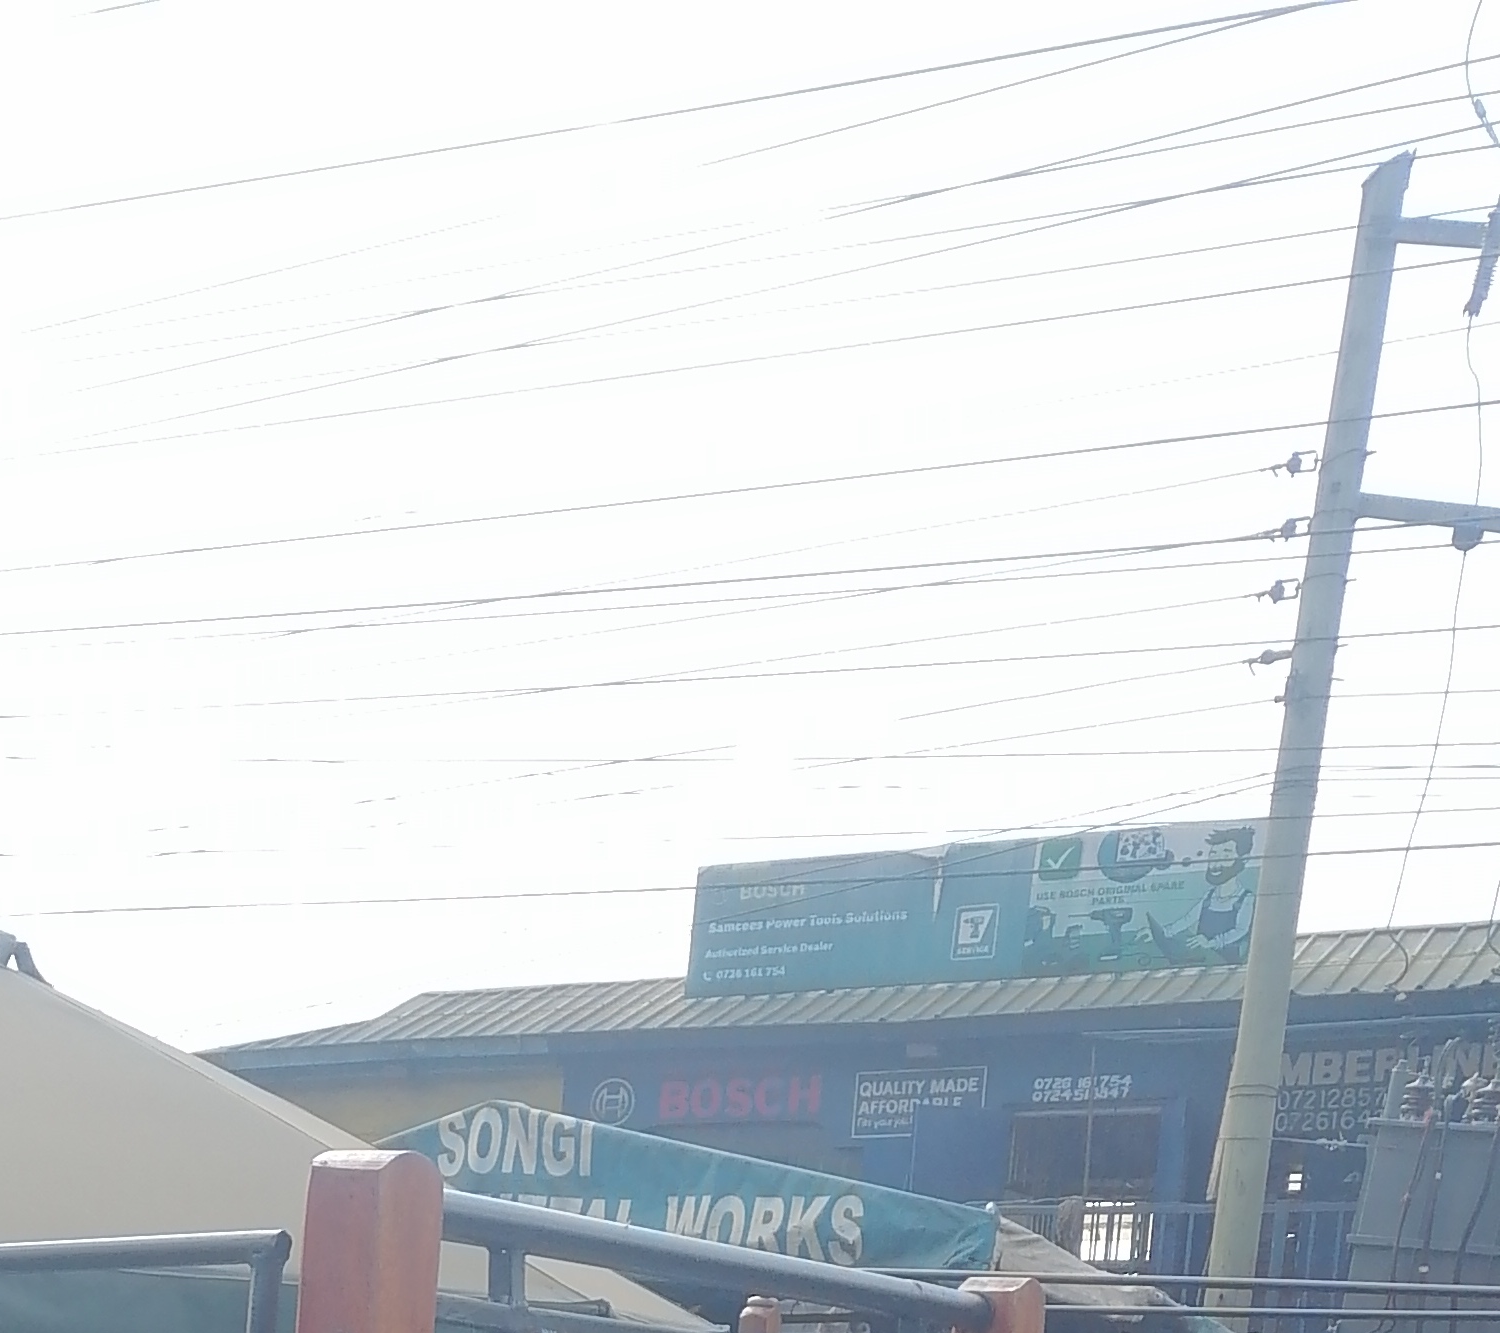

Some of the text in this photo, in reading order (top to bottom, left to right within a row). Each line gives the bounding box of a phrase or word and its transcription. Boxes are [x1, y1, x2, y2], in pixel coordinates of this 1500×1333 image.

[659, 1075, 822, 1118] BOSCH
[860, 1077, 979, 1097] QUALITY MADE
[438, 1106, 595, 1177] SONGI
[666, 1194, 864, 1265] WORKS
